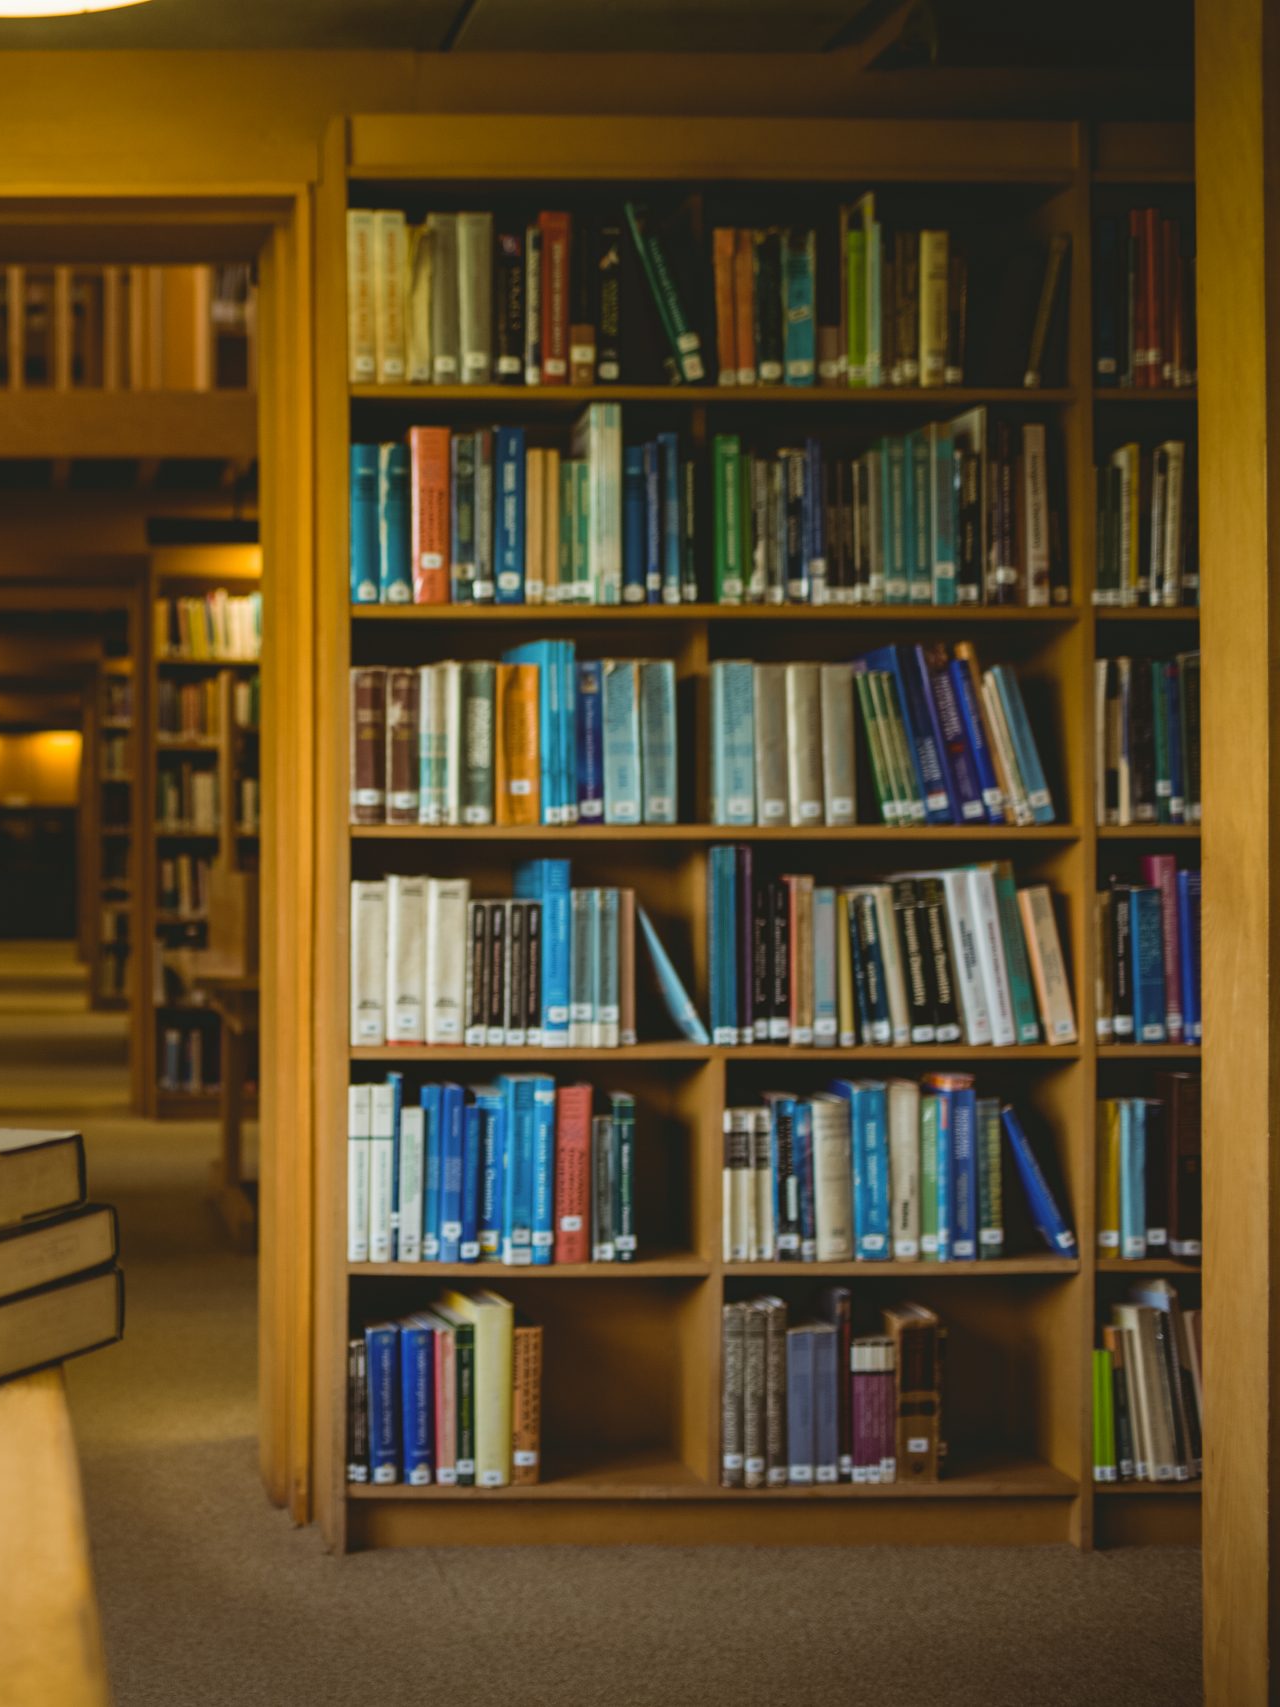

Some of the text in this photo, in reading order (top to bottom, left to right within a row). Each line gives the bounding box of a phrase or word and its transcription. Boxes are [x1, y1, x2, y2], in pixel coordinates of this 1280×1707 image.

[904, 908, 926, 1007] Inorganic Chemistry
[928, 907, 951, 1005] Inorganic Chemistry
[483, 1115, 497, 1222] Inorganic Chemistry
